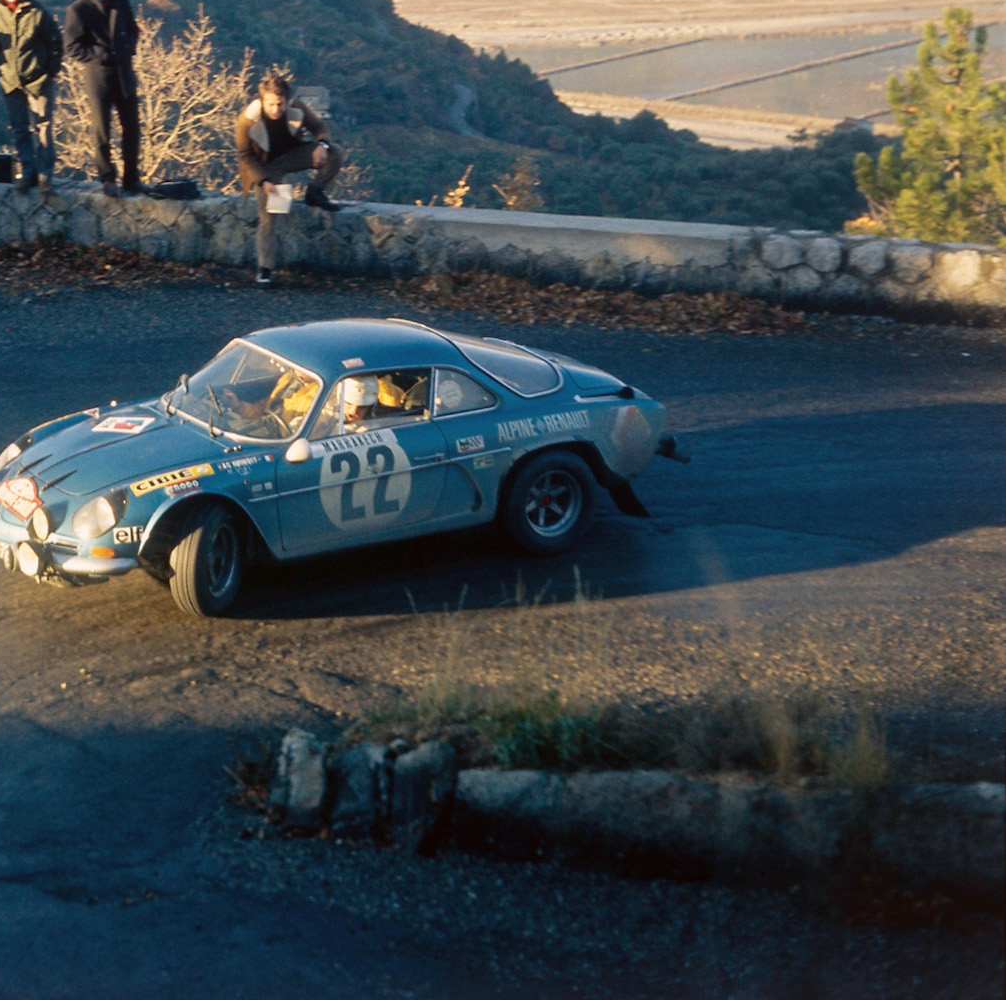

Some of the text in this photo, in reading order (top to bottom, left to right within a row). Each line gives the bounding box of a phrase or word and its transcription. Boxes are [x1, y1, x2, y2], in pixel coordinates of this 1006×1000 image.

[497, 410, 590, 442] ALPINE RENAULT
[321, 431, 384, 453] MARRAKECH
[330, 444, 401, 522] 22
[116, 526, 144, 543] elf
